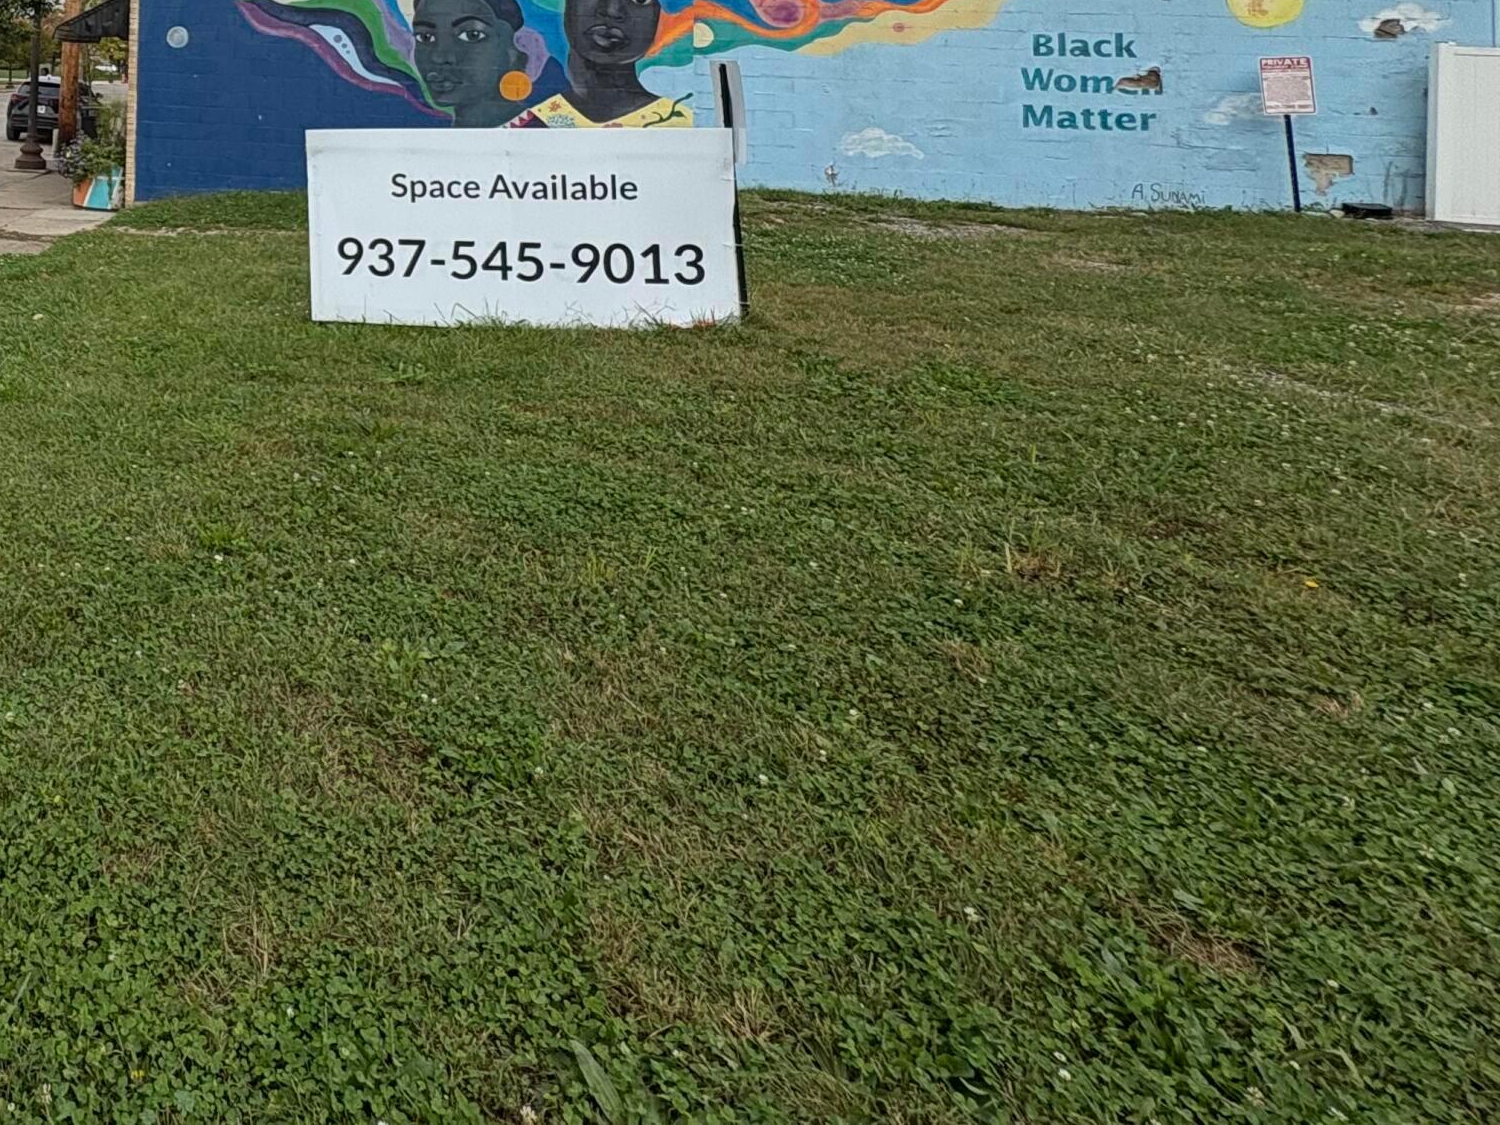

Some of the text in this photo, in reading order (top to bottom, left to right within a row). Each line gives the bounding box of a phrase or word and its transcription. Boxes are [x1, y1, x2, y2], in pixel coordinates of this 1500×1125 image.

[1032, 32, 1137, 58] Black
[1261, 58, 1308, 66] PRIVATE
[1021, 67, 1163, 95] Wom
[1022, 104, 1156, 131] Matter
[391, 173, 638, 203] Space Available
[337, 237, 706, 286] 937-545-9013
